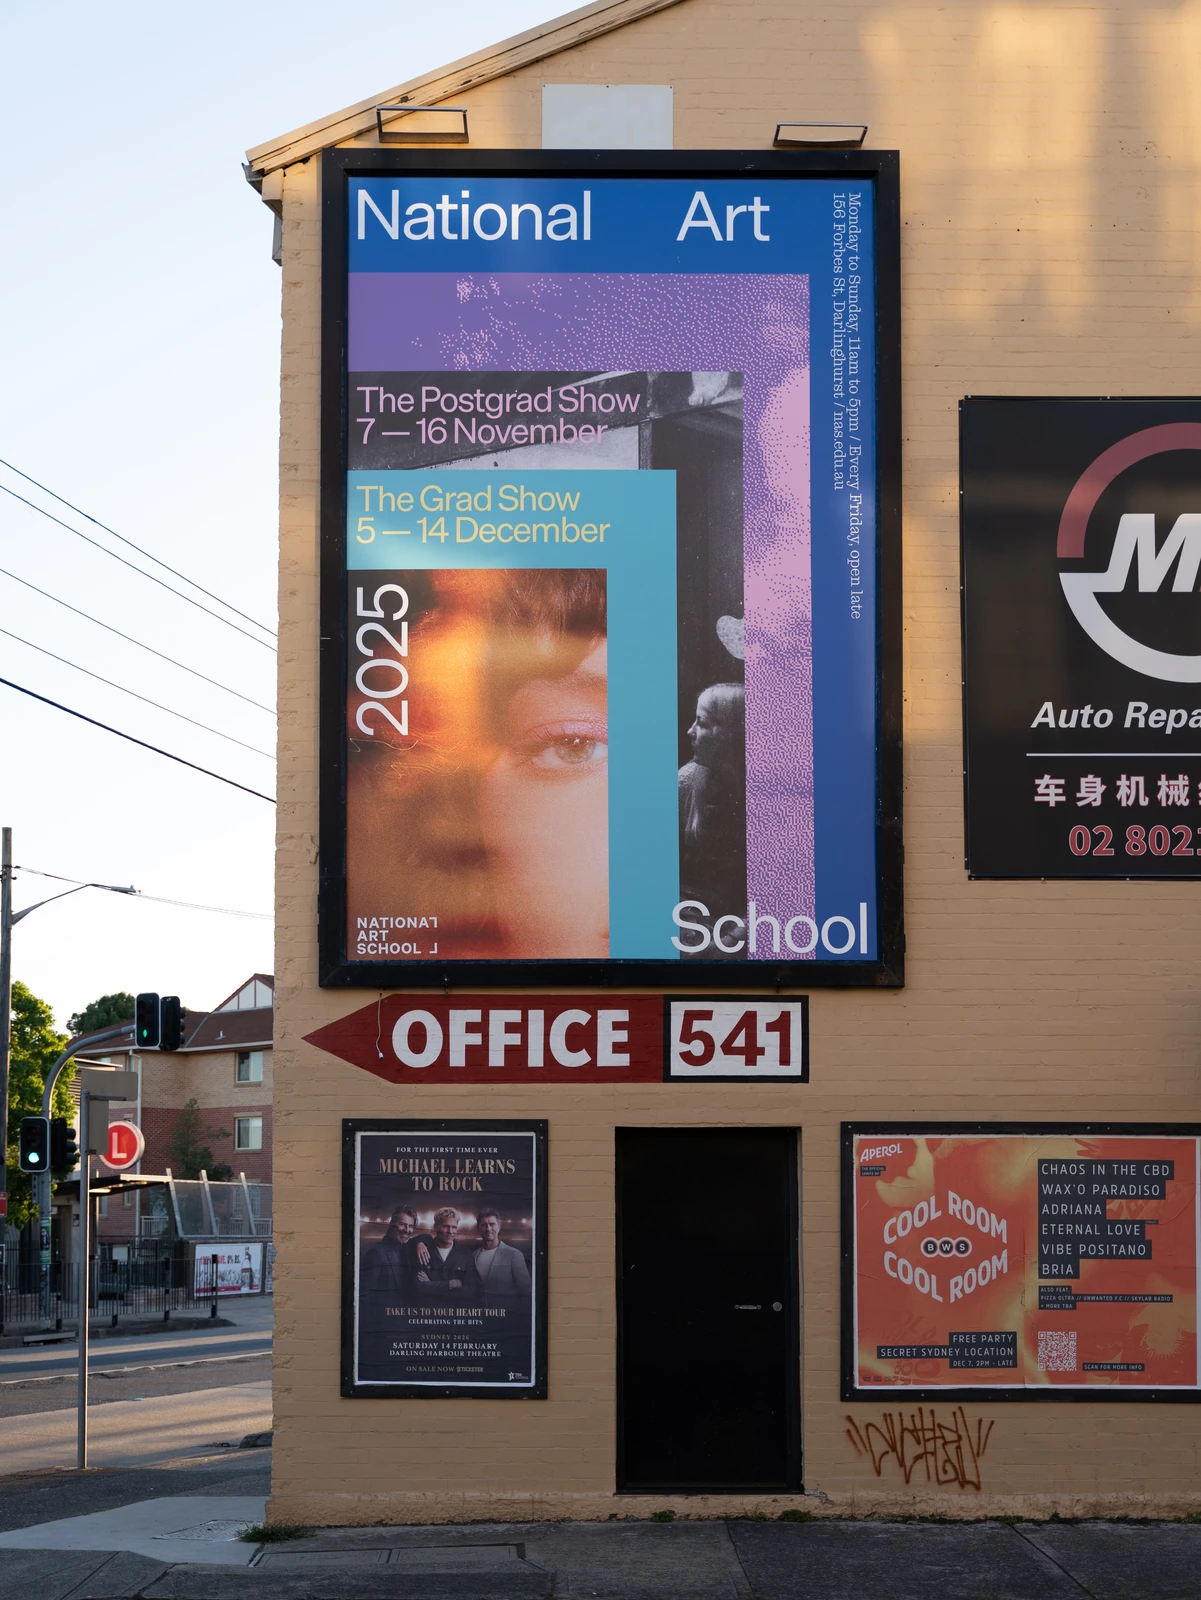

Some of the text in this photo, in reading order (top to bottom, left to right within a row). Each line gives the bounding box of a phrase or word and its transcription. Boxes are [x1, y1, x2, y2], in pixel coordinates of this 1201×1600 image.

[356, 189, 771, 242] National Art
[833, 193, 846, 219] 156
[846, 192, 862, 253] Monday
[833, 222, 846, 273] Forbes
[848, 257, 860, 271] to
[832, 277, 846, 297] St,
[845, 275, 862, 333] Sunday,
[830, 301, 846, 399] Darlinghurst
[848, 338, 861, 375] 11am
[848, 379, 860, 394] to
[356, 385, 641, 420] The Postgrad Show
[846, 398, 862, 431] 5pm
[356, 418, 376, 444] 7
[416, 417, 447, 444] 16
[454, 417, 609, 444] November
[833, 412, 847, 490] nas.edu.au
[846, 445, 862, 490] Every
[356, 484, 581, 512] The Grad Show
[355, 517, 376, 544] 5
[416, 516, 449, 543] 14
[456, 516, 611, 543] December
[846, 493, 863, 547] Friday,
[1098, 513, 1201, 592] M
[847, 550, 861, 587] open
[850, 590, 864, 619] late
[355, 583, 409, 736] 2025
[1030, 701, 1114, 729] Auto
[1034, 774, 1201, 807] 车身机械
[1068, 824, 1201, 856] 02 802
[357, 930, 389, 941] ART
[670, 900, 867, 955] School
[357, 942, 421, 954] SCHOOL
[391, 1009, 792, 1069] OFFICE 541
[111, 1131, 128, 1159] L
[860, 1143, 903, 1163] APEROL
[379, 1158, 516, 1174] MICHAEL LEARNS
[1041, 1164, 1170, 1176] CHAOS IN THE CBD
[411, 1176, 483, 1191] TO ROCK
[1092, 1184, 1160, 1196] PARADISO
[883, 1190, 1007, 1245] COOL ROOM
[1041, 1204, 1102, 1215] ADRIANA
[1042, 1224, 1141, 1236] ETERNAL LOVE
[927, 1243, 966, 1252] BWS
[1042, 1244, 1146, 1256] VIBE POSITANO
[883, 1249, 1008, 1303] COOL ROOM
[1042, 1264, 1074, 1275] BRIA
[385, 1307, 506, 1317] TAKE US TO YOUR HEART TOUR
[880, 1347, 1014, 1357] SECRET SYDNEY LOCATION
[952, 1334, 1013, 1343] FREE PARTY
